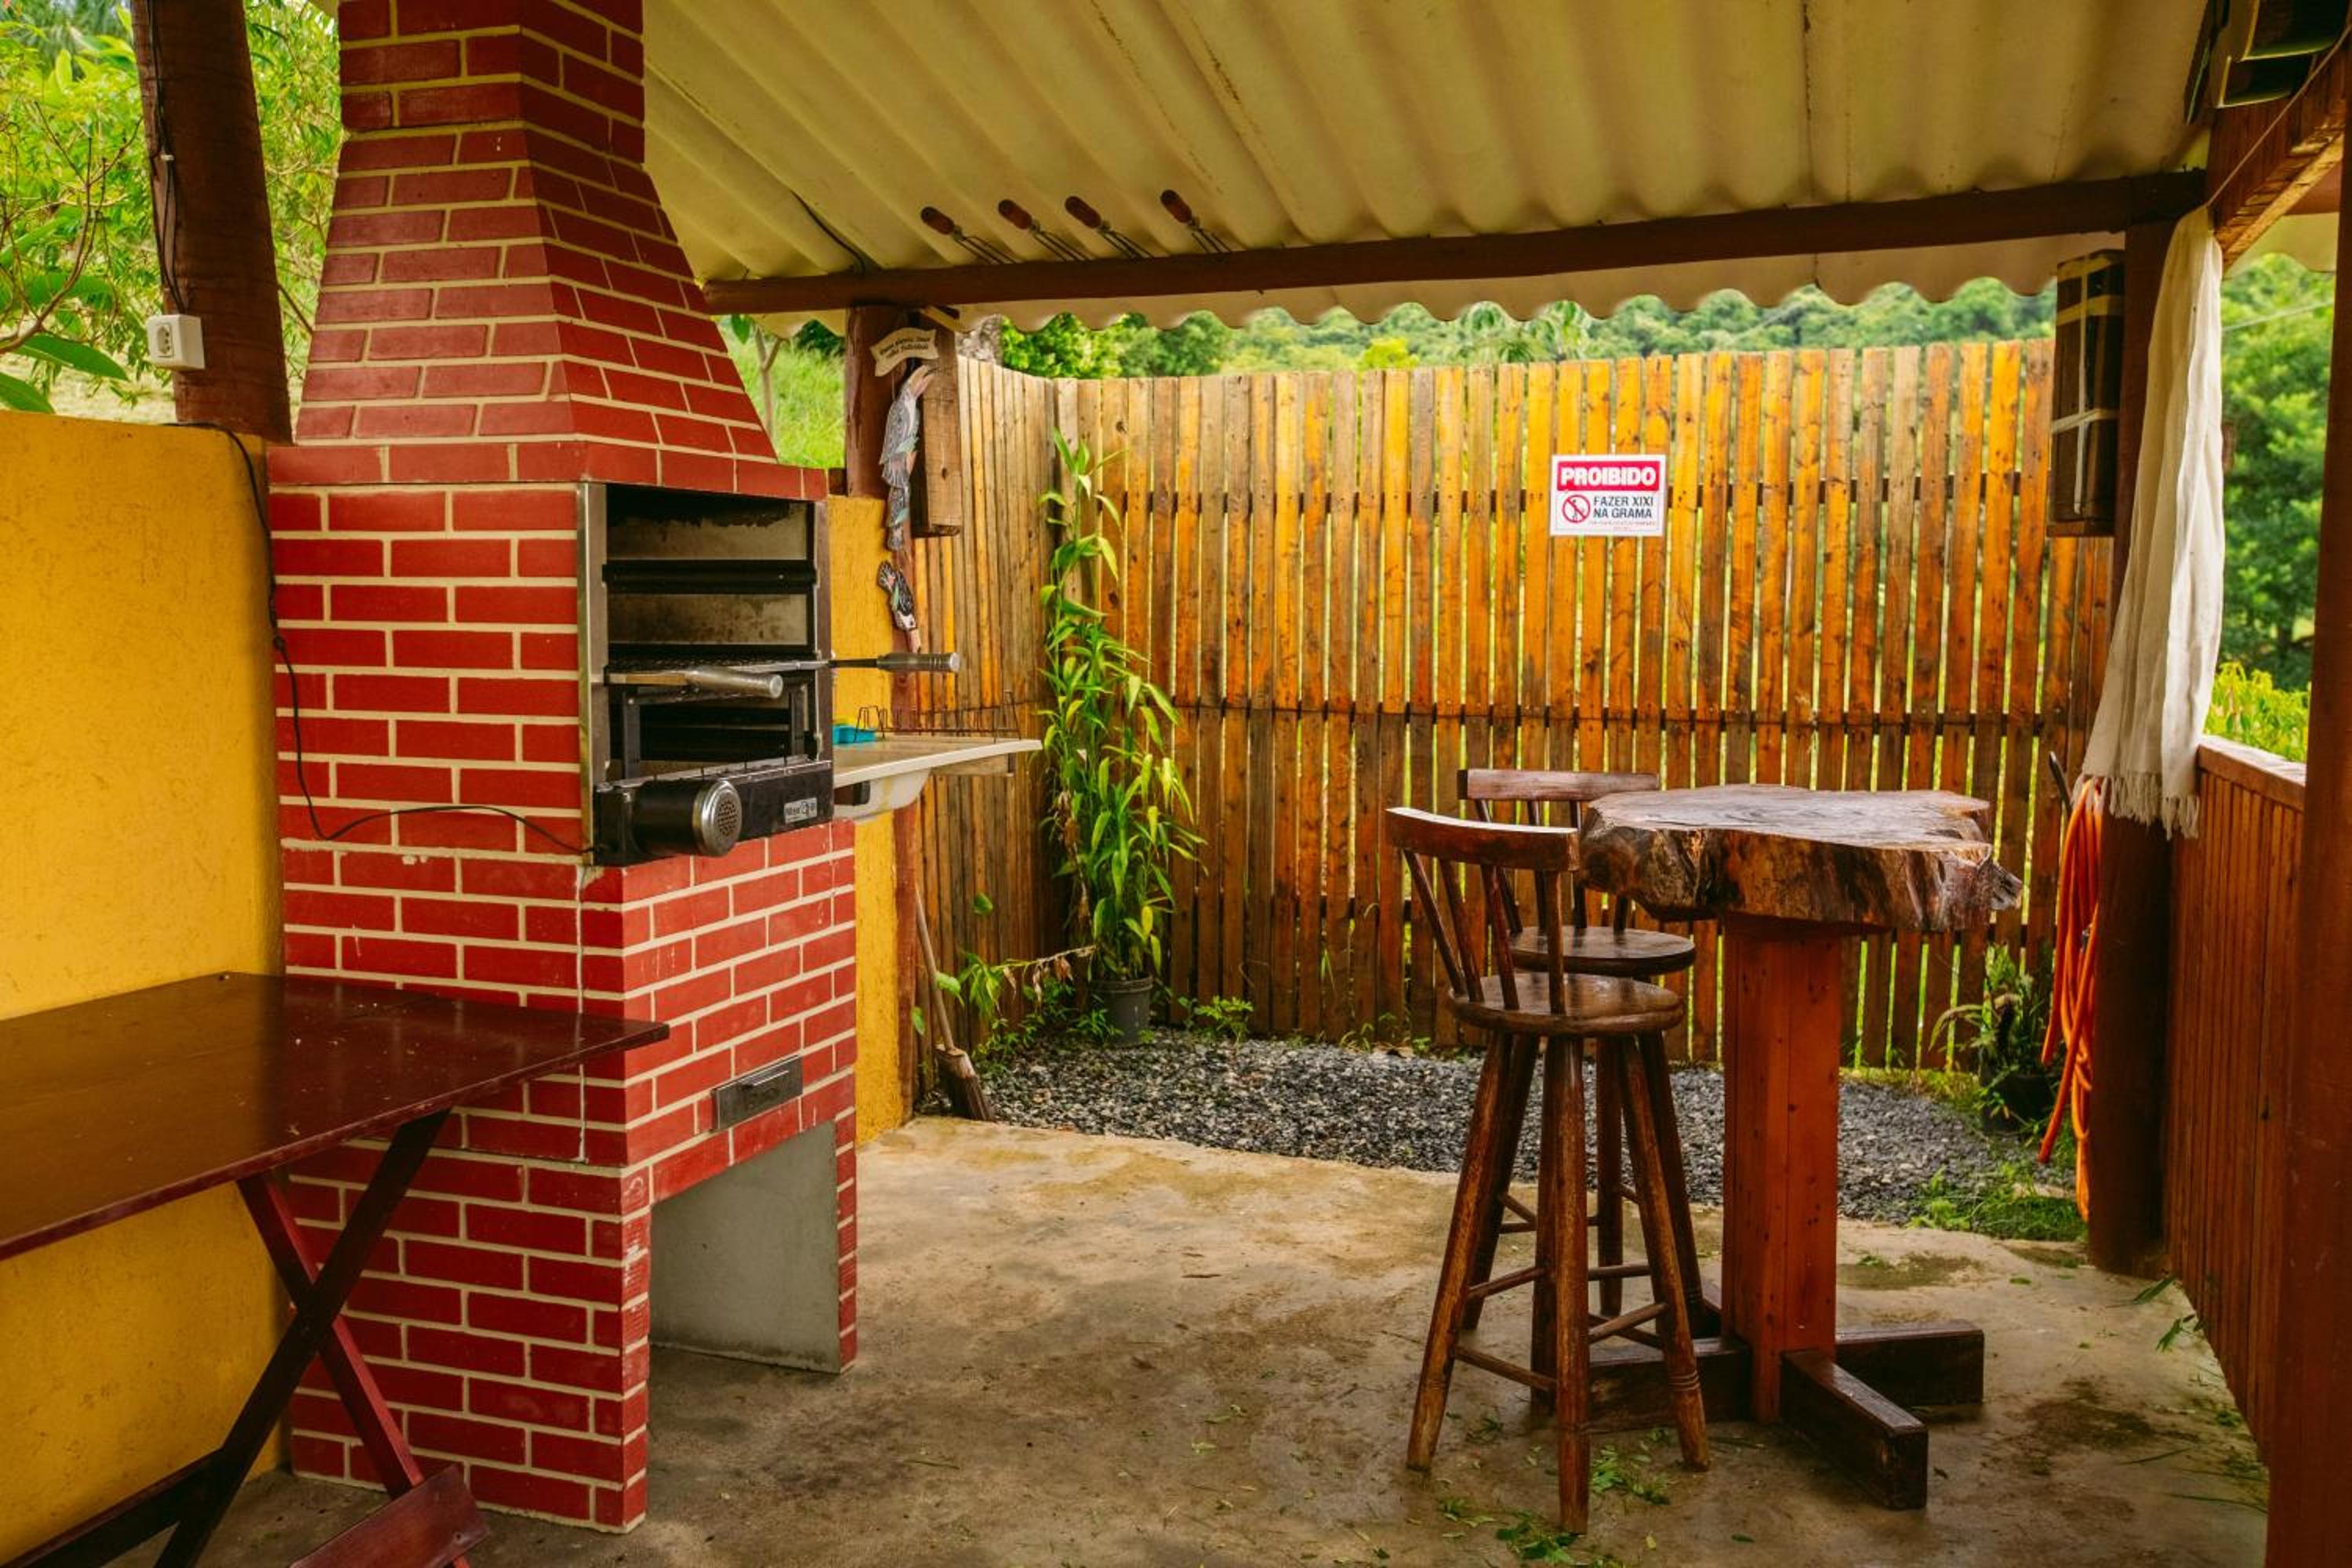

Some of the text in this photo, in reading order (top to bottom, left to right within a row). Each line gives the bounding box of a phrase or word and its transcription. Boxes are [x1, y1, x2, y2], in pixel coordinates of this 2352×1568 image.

[1560, 466, 1657, 486] PROIBIDO
[1593, 496, 1653, 506] FAZER XIXI
[1593, 508, 1652, 518] NA GRAMA
